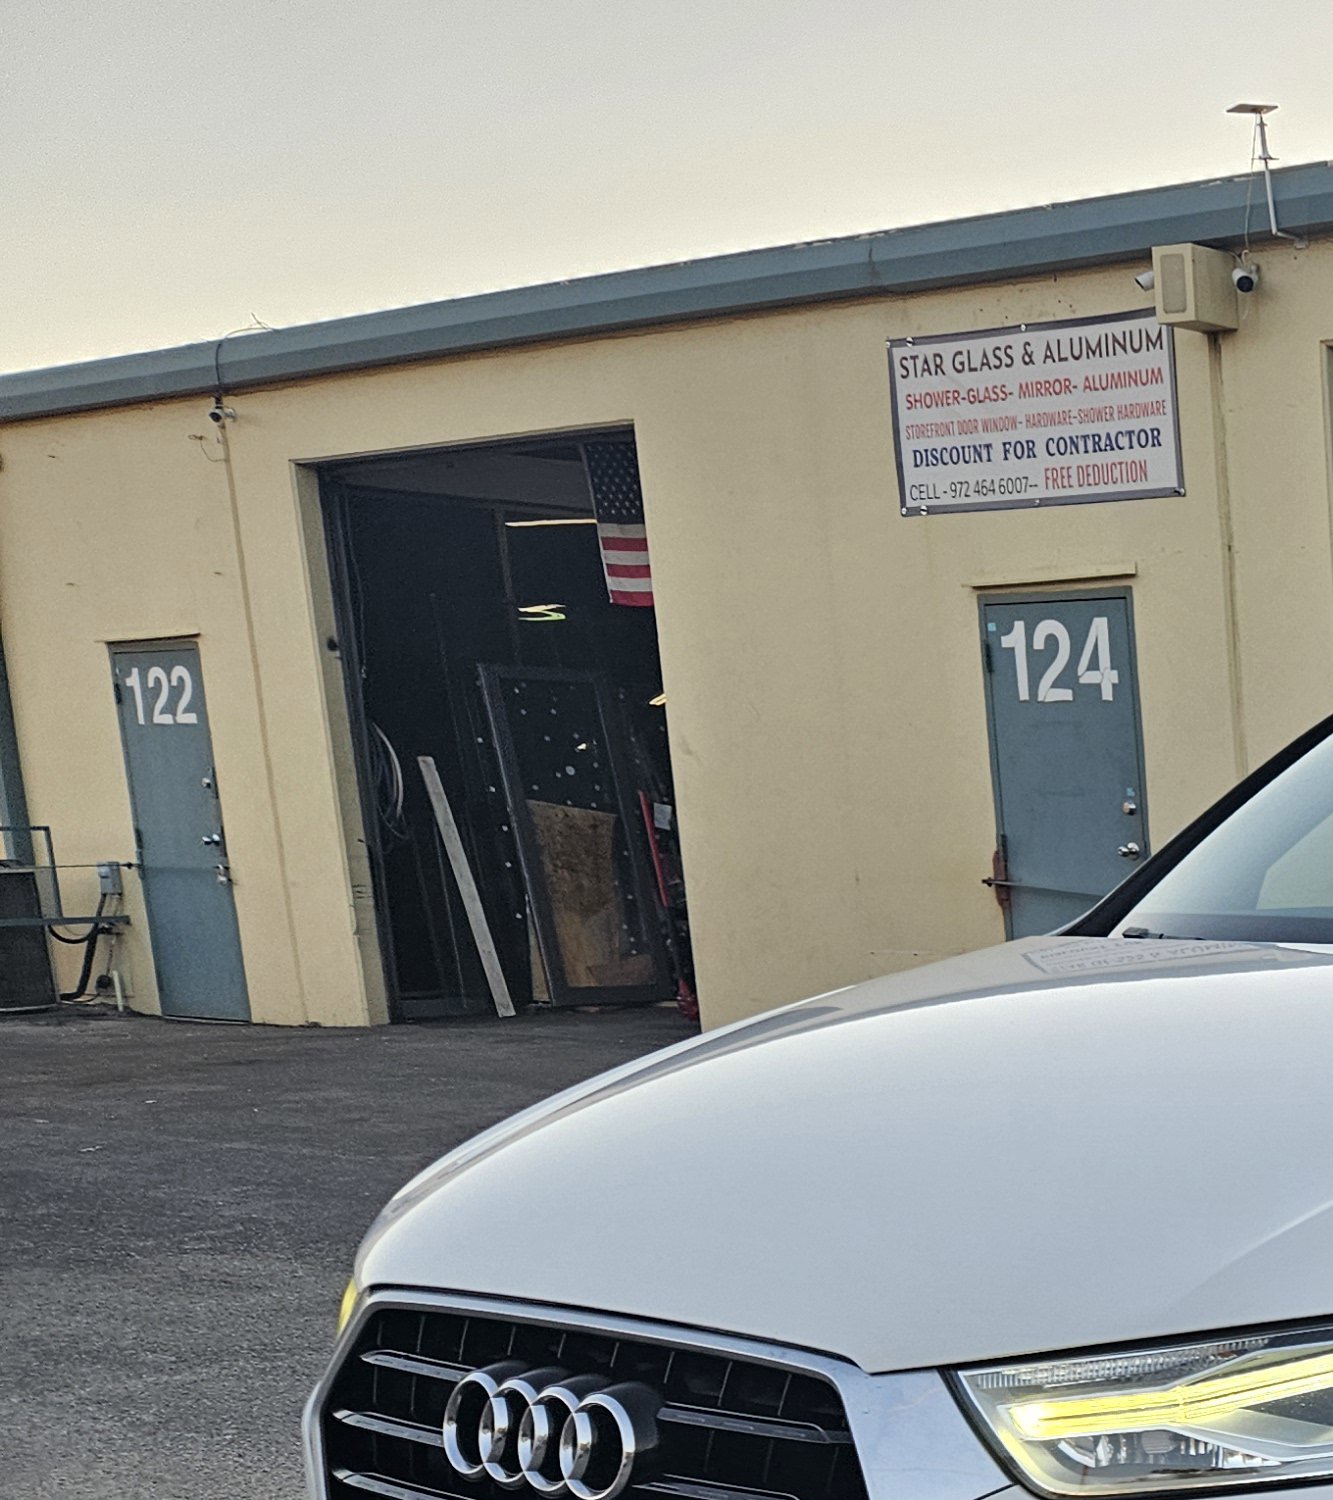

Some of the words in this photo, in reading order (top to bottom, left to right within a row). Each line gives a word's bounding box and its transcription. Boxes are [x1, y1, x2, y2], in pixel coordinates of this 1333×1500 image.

[899, 353, 946, 379] STAR
[952, 344, 1014, 374] GLASS
[1021, 341, 1036, 366] &
[1042, 326, 1164, 364] ALUMINUM
[1018, 378, 1078, 399] MIRROR-
[1083, 367, 1164, 392] ALUMINUM
[905, 421, 955, 440] STOREFRONT
[958, 418, 979, 435] DOOR
[1117, 400, 1167, 420] HARDWARE
[912, 443, 993, 468] DISCOUNT
[1002, 439, 1037, 461] FOR
[1045, 427, 1162, 457] CONTRACTOR
[909, 483, 941, 500] CELL
[950, 480, 971, 498] 972
[973, 479, 996, 496] 464
[1044, 466, 1074, 490] FREE
[1077, 459, 1148, 488] DEDUCTION
[1000, 617, 1119, 702] 124
[125, 665, 198, 725] 122
